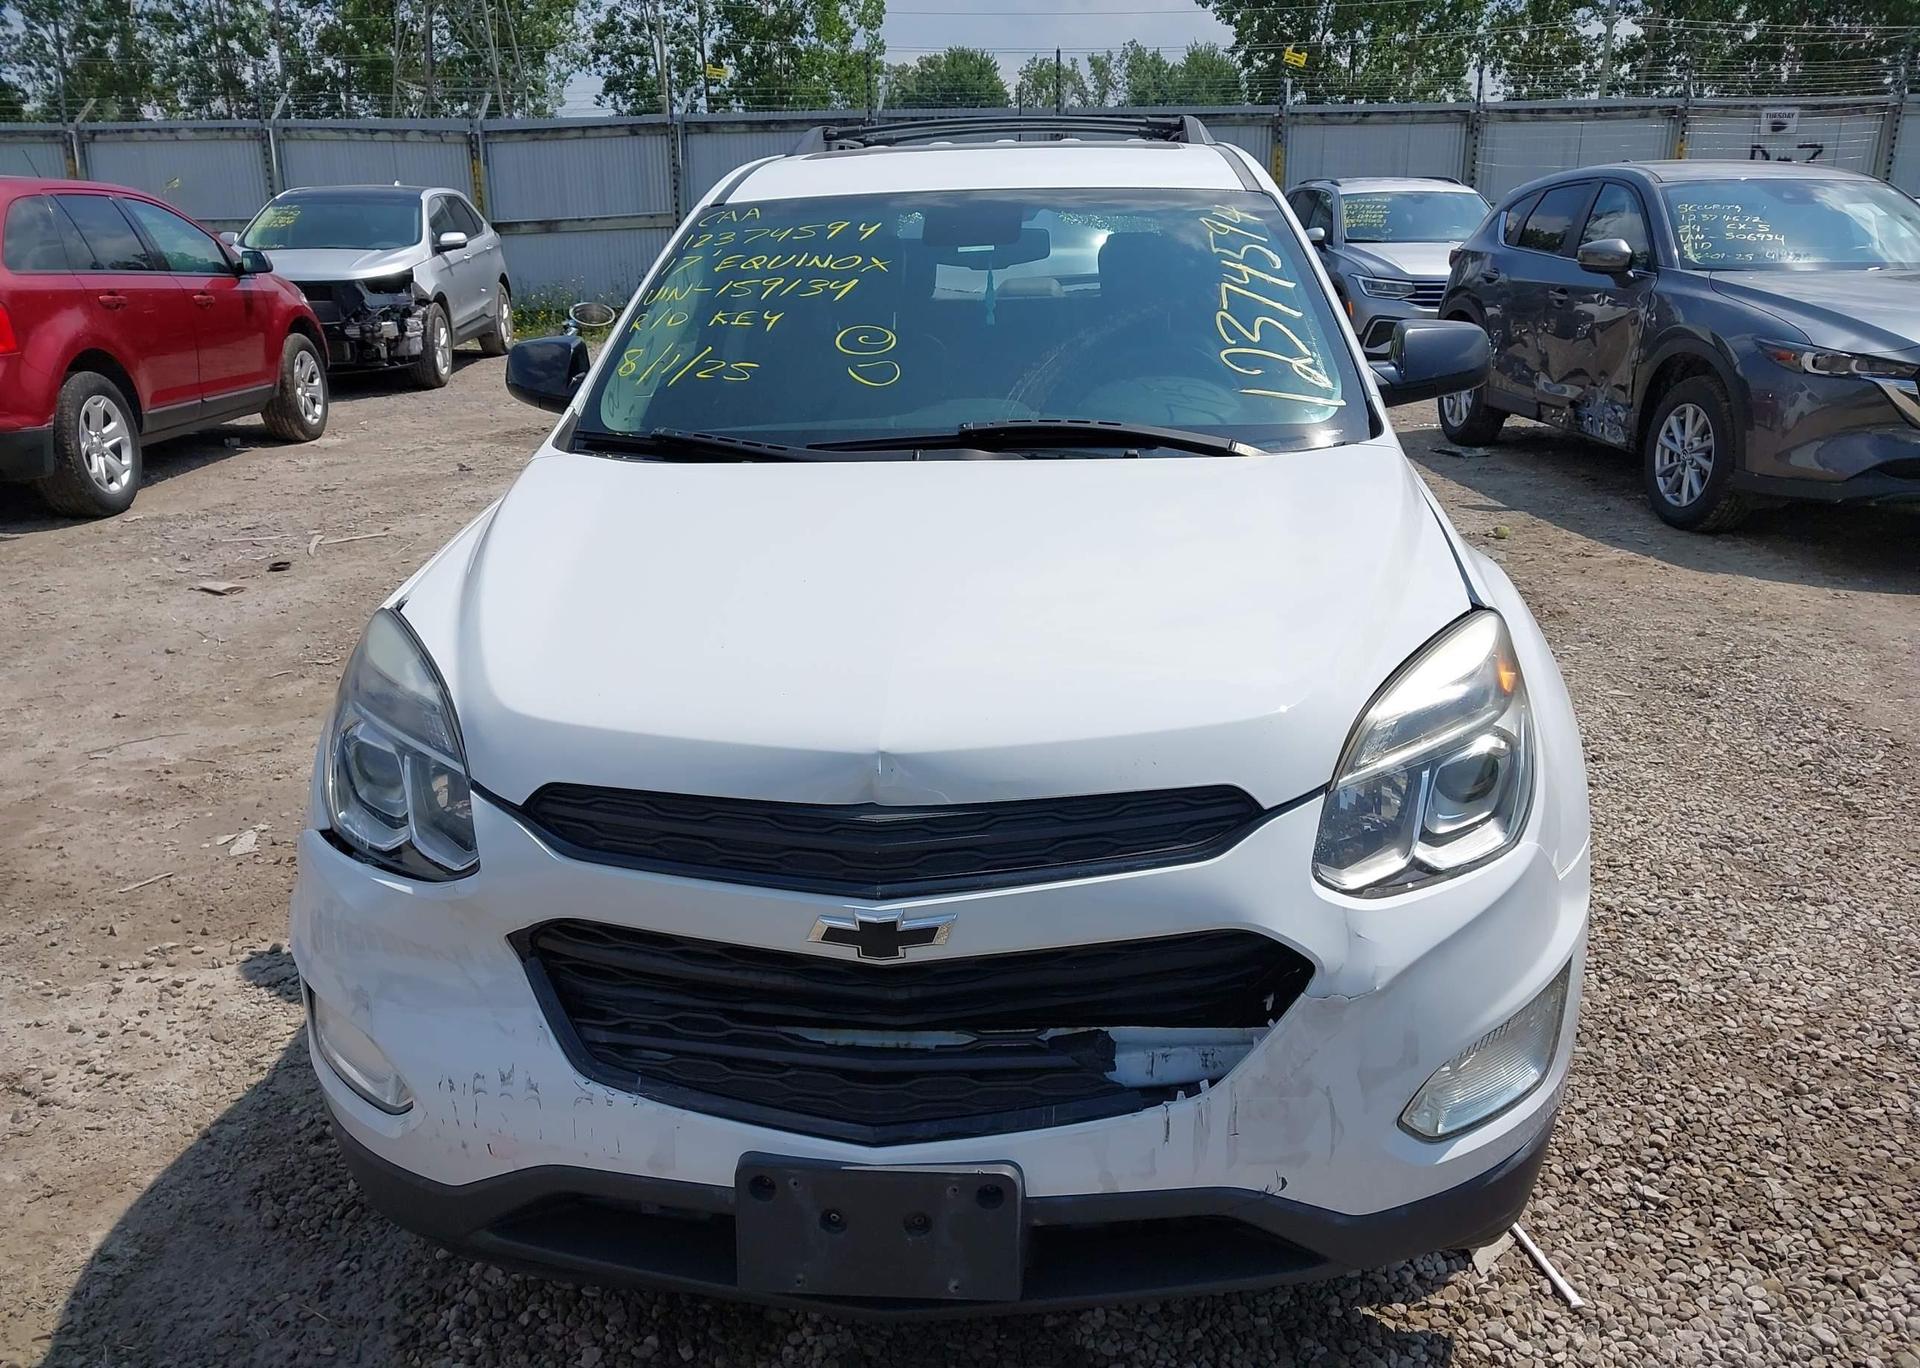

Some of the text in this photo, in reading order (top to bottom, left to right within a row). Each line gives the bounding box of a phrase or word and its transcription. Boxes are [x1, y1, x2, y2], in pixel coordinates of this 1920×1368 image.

[698, 207, 760, 228] CAA
[707, 310, 785, 332] KEY
[617, 342, 760, 388] 8/1/25
